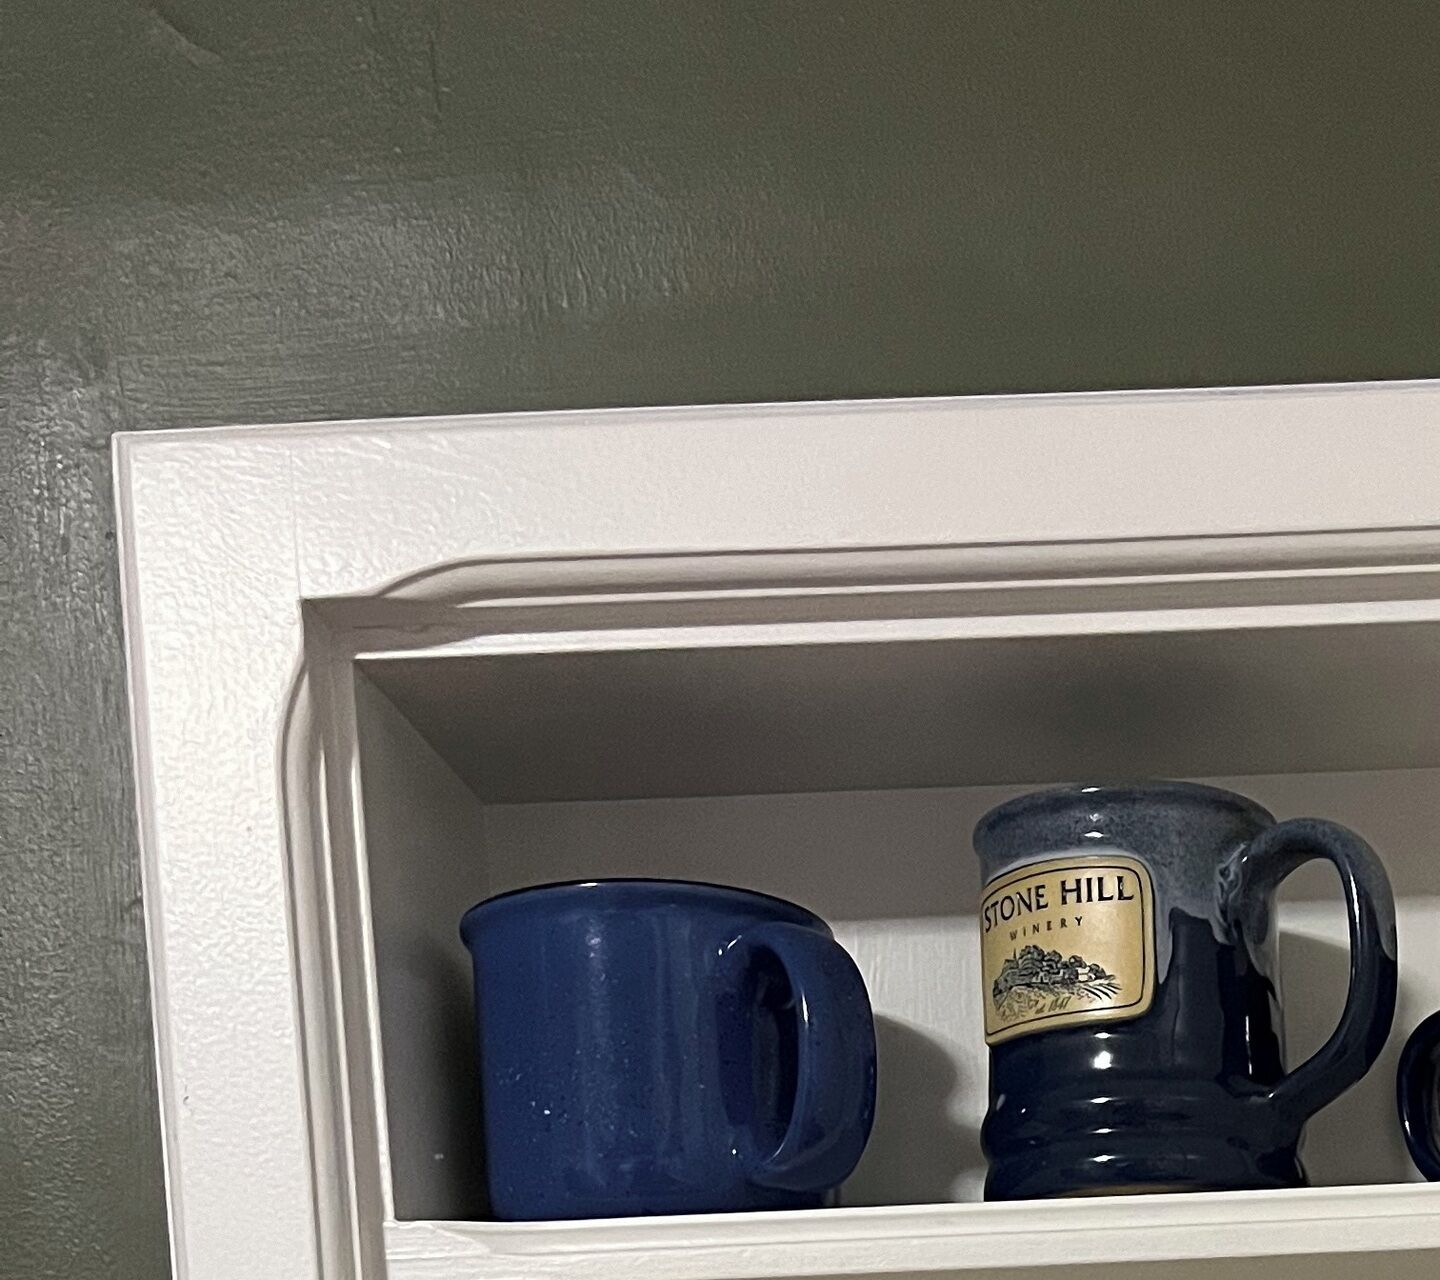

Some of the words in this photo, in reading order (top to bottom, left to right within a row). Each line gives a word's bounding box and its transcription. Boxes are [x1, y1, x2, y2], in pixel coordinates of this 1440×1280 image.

[984, 884, 1048, 933] STONE
[1060, 875, 1134, 905] HILL
[1009, 916, 1083, 940] WINERY
